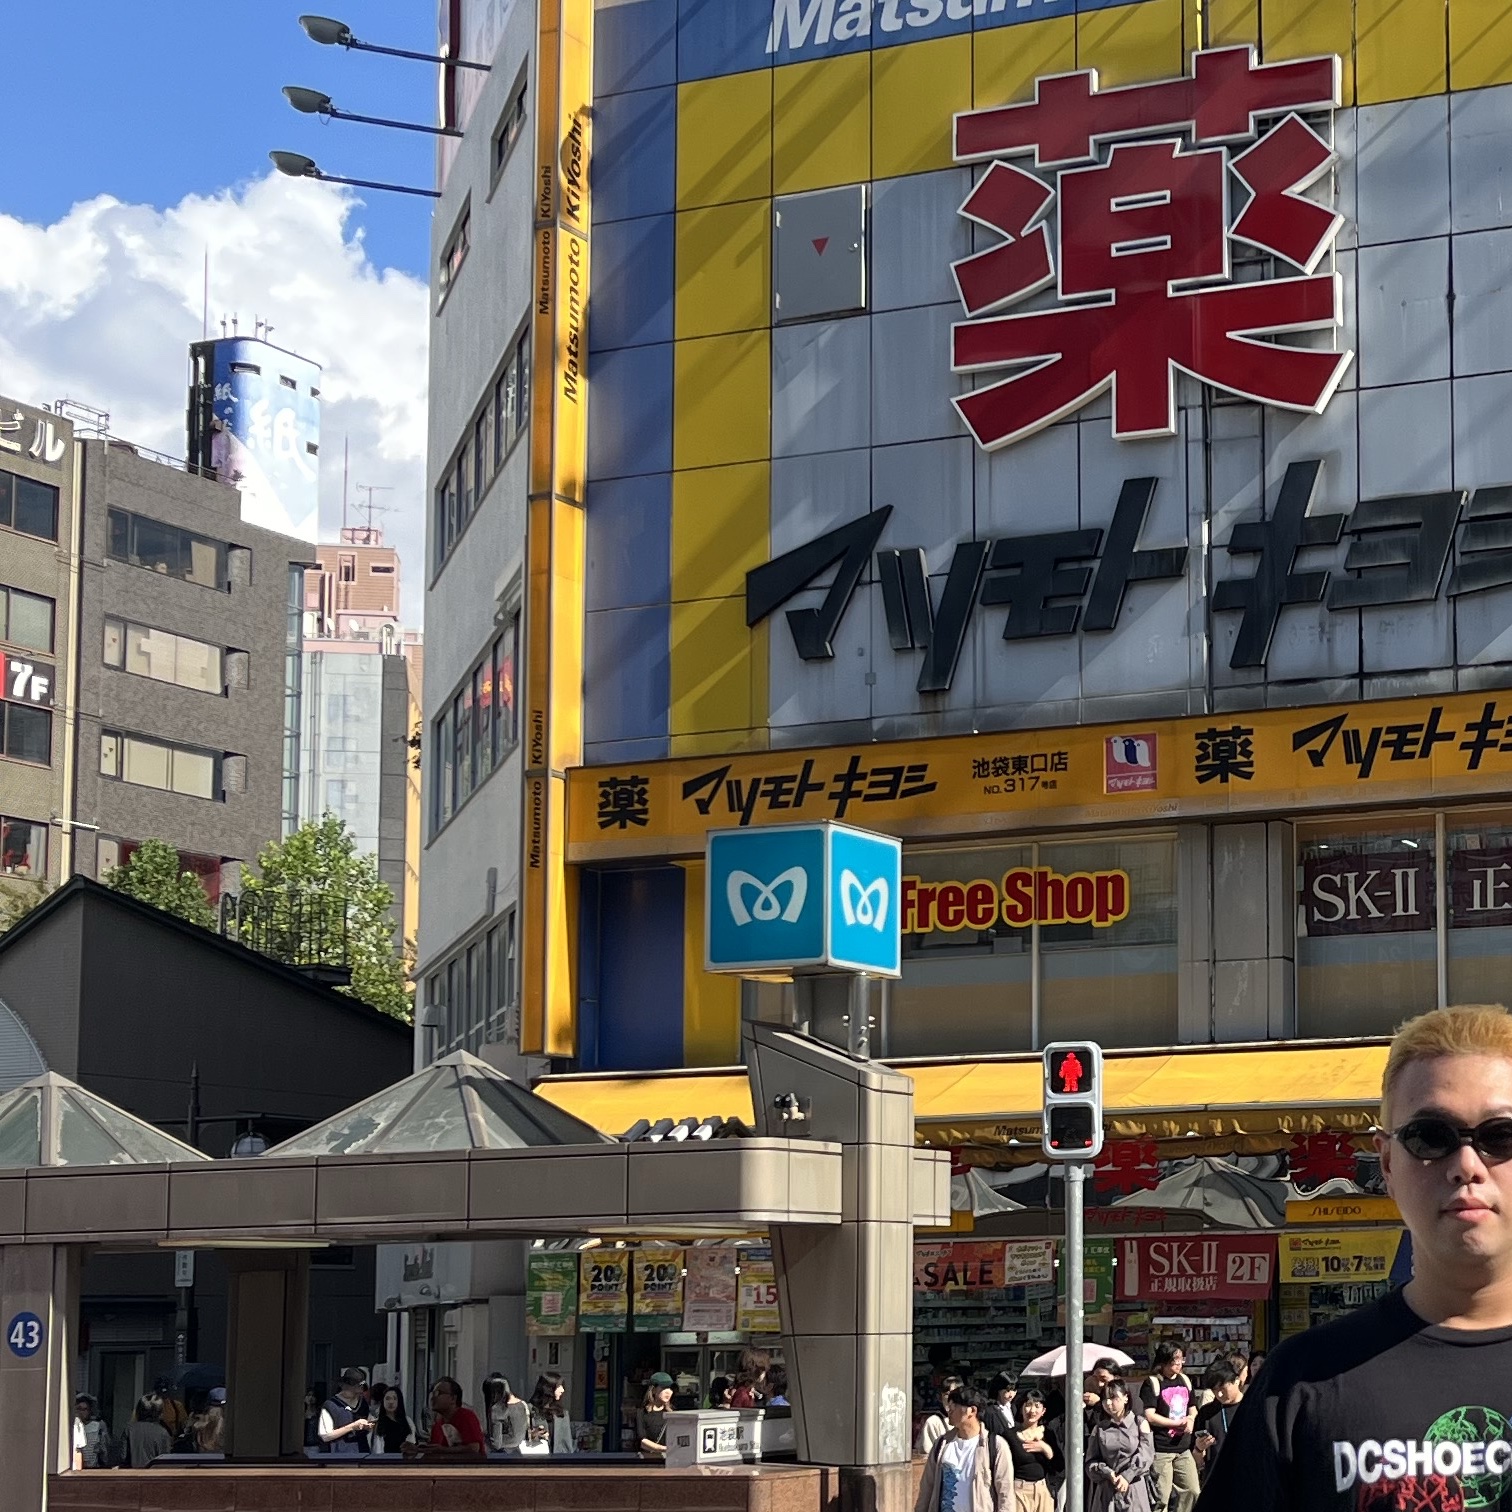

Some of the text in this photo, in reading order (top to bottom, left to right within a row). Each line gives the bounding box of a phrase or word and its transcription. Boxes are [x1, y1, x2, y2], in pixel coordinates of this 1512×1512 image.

[539, 166, 551, 315] Matsumoto KiYoshi
[564, 112, 582, 404] Matsumoto KiYoshi
[951, 44, 1355, 451] 薬
[10, 661, 49, 701] 7F
[972, 751, 1069, 779] 池袋東口店
[1195, 726, 1255, 784] 薬
[529, 710, 543, 869] Matsumoto KiYoshi
[597, 755, 938, 831] 薬 マツモトキヨシ
[902, 867, 1131, 932] Free Shop
[1309, 1205, 1361, 1217] SHISEIDO
[1148, 1275, 1218, 1294] 正規取扱店
[1230, 1255, 1268, 1282] 2F
[9, 1321, 41, 1350] 43
